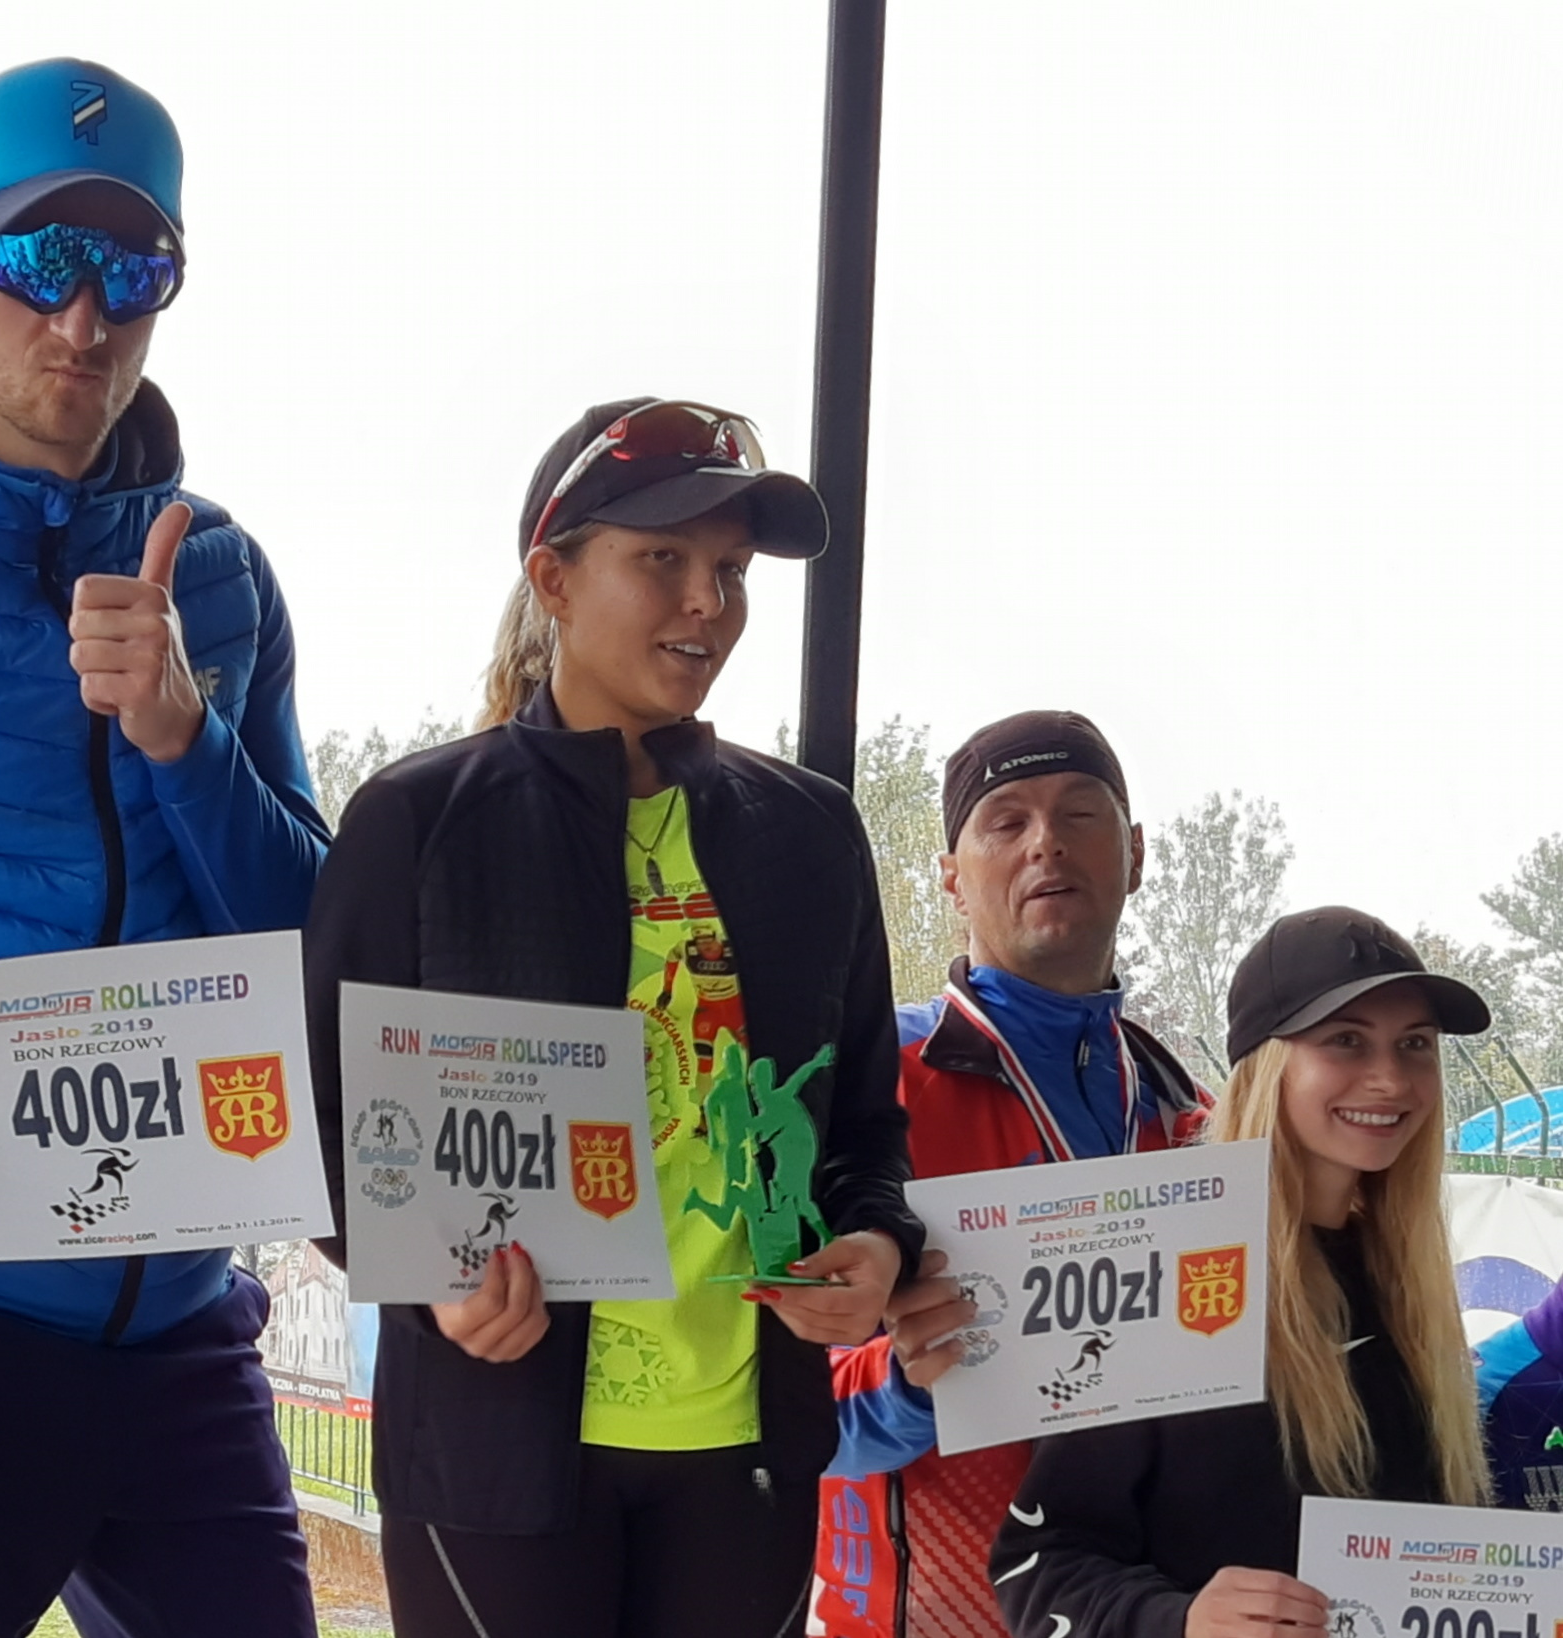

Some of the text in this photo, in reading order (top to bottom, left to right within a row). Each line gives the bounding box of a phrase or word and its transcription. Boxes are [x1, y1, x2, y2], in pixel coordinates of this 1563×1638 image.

[998, 751, 1070, 773] ATOMIC
[100, 973, 249, 1011] ROLLSPEED
[89, 1017, 154, 1035] 2019
[13, 1036, 167, 1062] BON RZECZOWY
[381, 1026, 421, 1056] RUN
[501, 1037, 607, 1068] ROLLSPEED
[492, 1071, 538, 1086] 2019
[12, 1056, 185, 1149] 400zł
[440, 1086, 548, 1105] BON RZECZOWY
[434, 1106, 556, 1190] 400zł
[958, 1205, 1007, 1232] RUN
[1103, 1177, 1225, 1213] ROLLSPEED
[58, 1232, 157, 1246] www.zicoracing.com
[1092, 1218, 1146, 1235] 2019
[1031, 1233, 1156, 1260] BON RZECZOWY
[1021, 1250, 1163, 1337] 200zł
[1346, 1534, 1391, 1560] RUN
[1471, 1573, 1525, 1588] 2019
[1410, 1587, 1534, 1605] BON RZECZOWY
